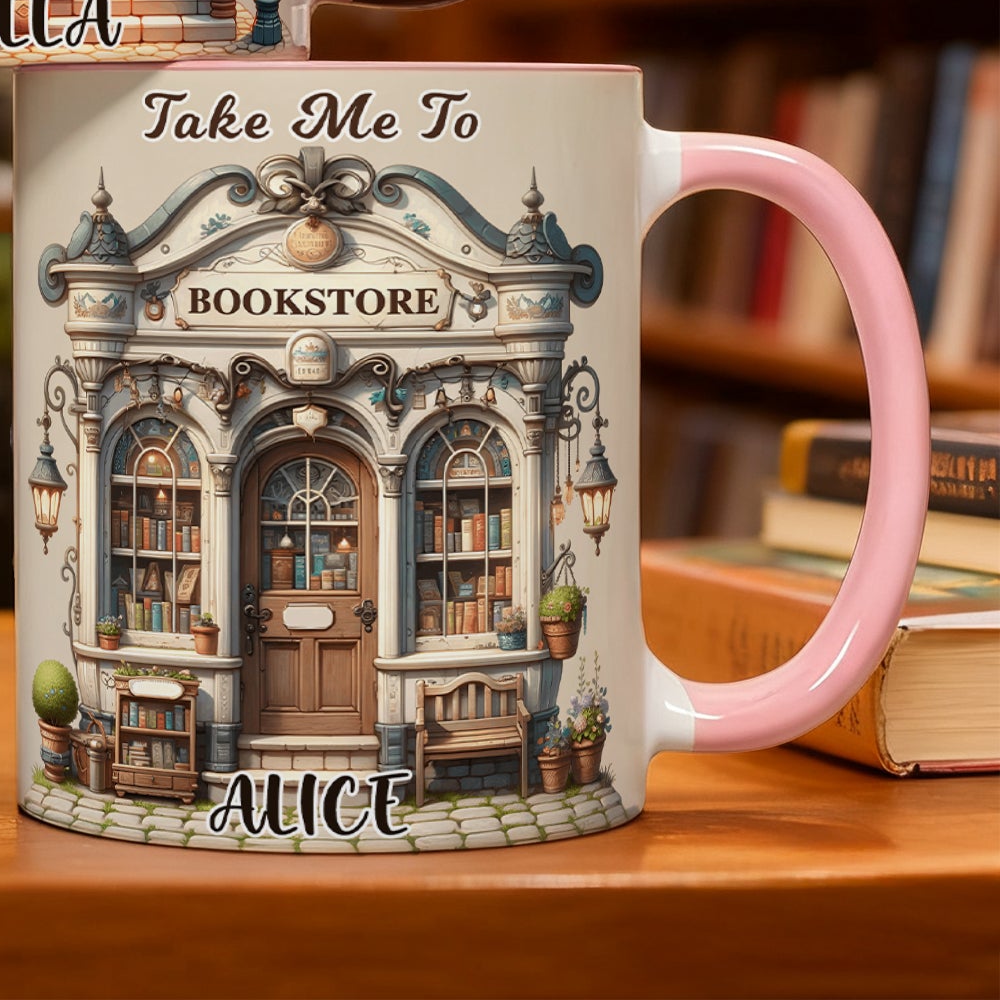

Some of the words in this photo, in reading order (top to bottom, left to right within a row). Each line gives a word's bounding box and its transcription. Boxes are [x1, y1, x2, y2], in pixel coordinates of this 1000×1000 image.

[144, 92, 270, 139] Take
[291, 92, 399, 139] Me
[421, 92, 479, 139] To
[188, 287, 440, 316] BOOKSTORE
[209, 772, 412, 837] ALICE
